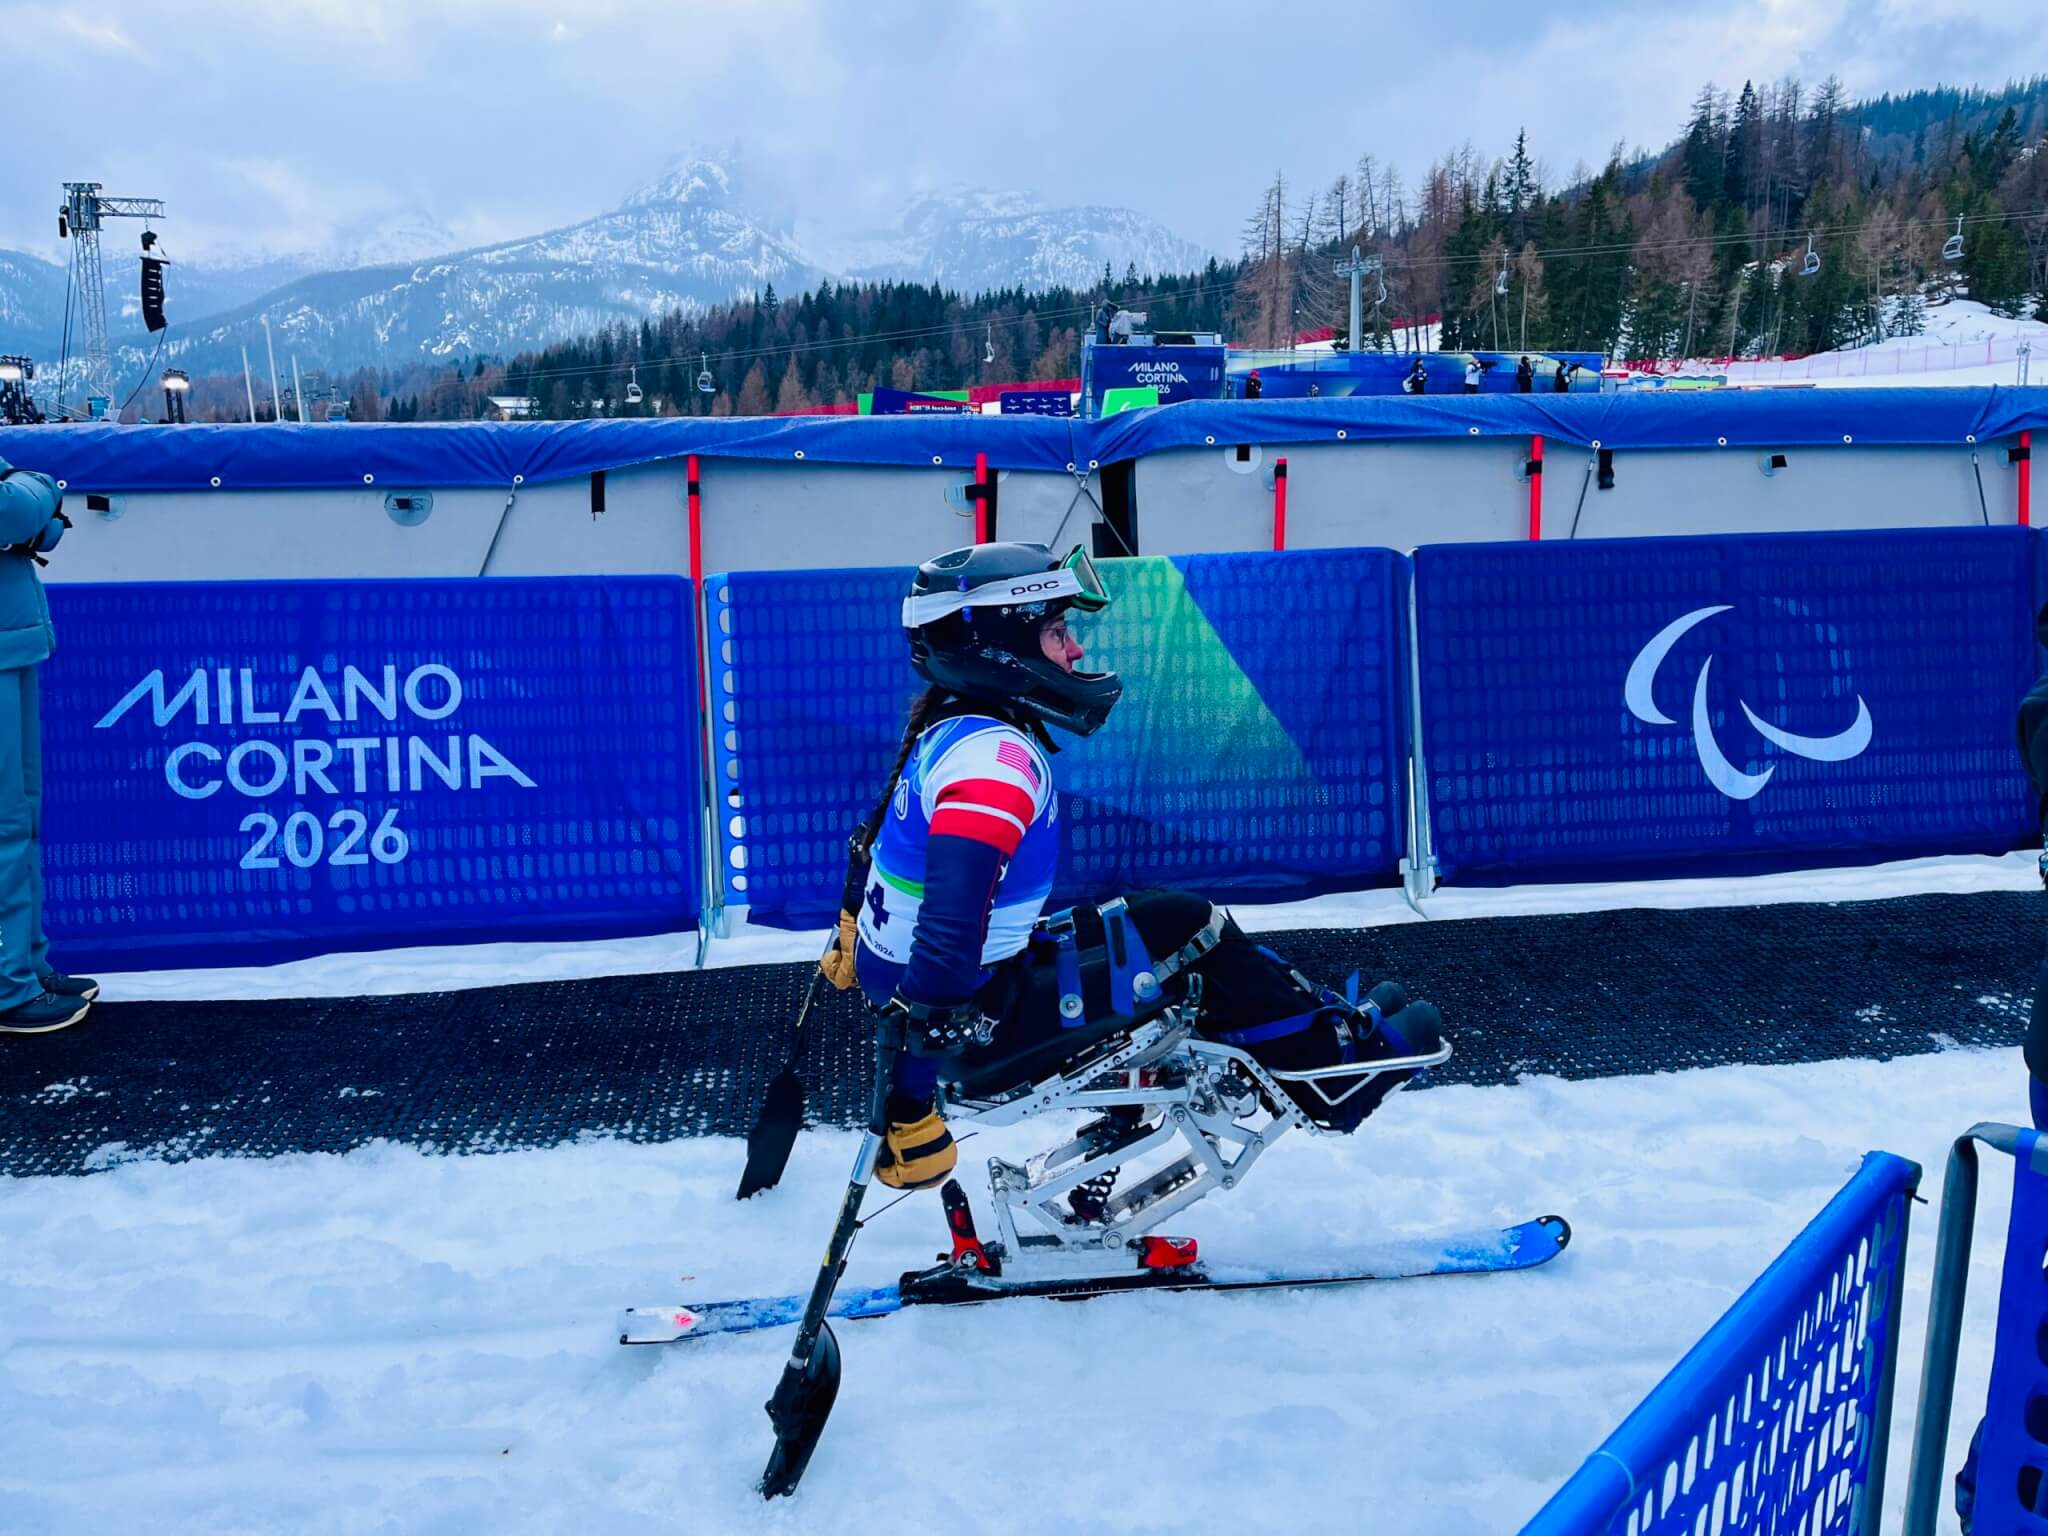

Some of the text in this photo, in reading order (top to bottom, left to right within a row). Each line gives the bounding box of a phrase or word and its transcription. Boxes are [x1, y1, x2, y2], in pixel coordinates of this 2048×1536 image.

[1128, 362, 1179, 372] MILANO
[1136, 373, 1188, 383] CORTINA
[1010, 580, 1059, 596] POC
[93, 664, 463, 728] MILANO
[165, 733, 538, 800] CORTINA
[239, 808, 409, 869] 2026
